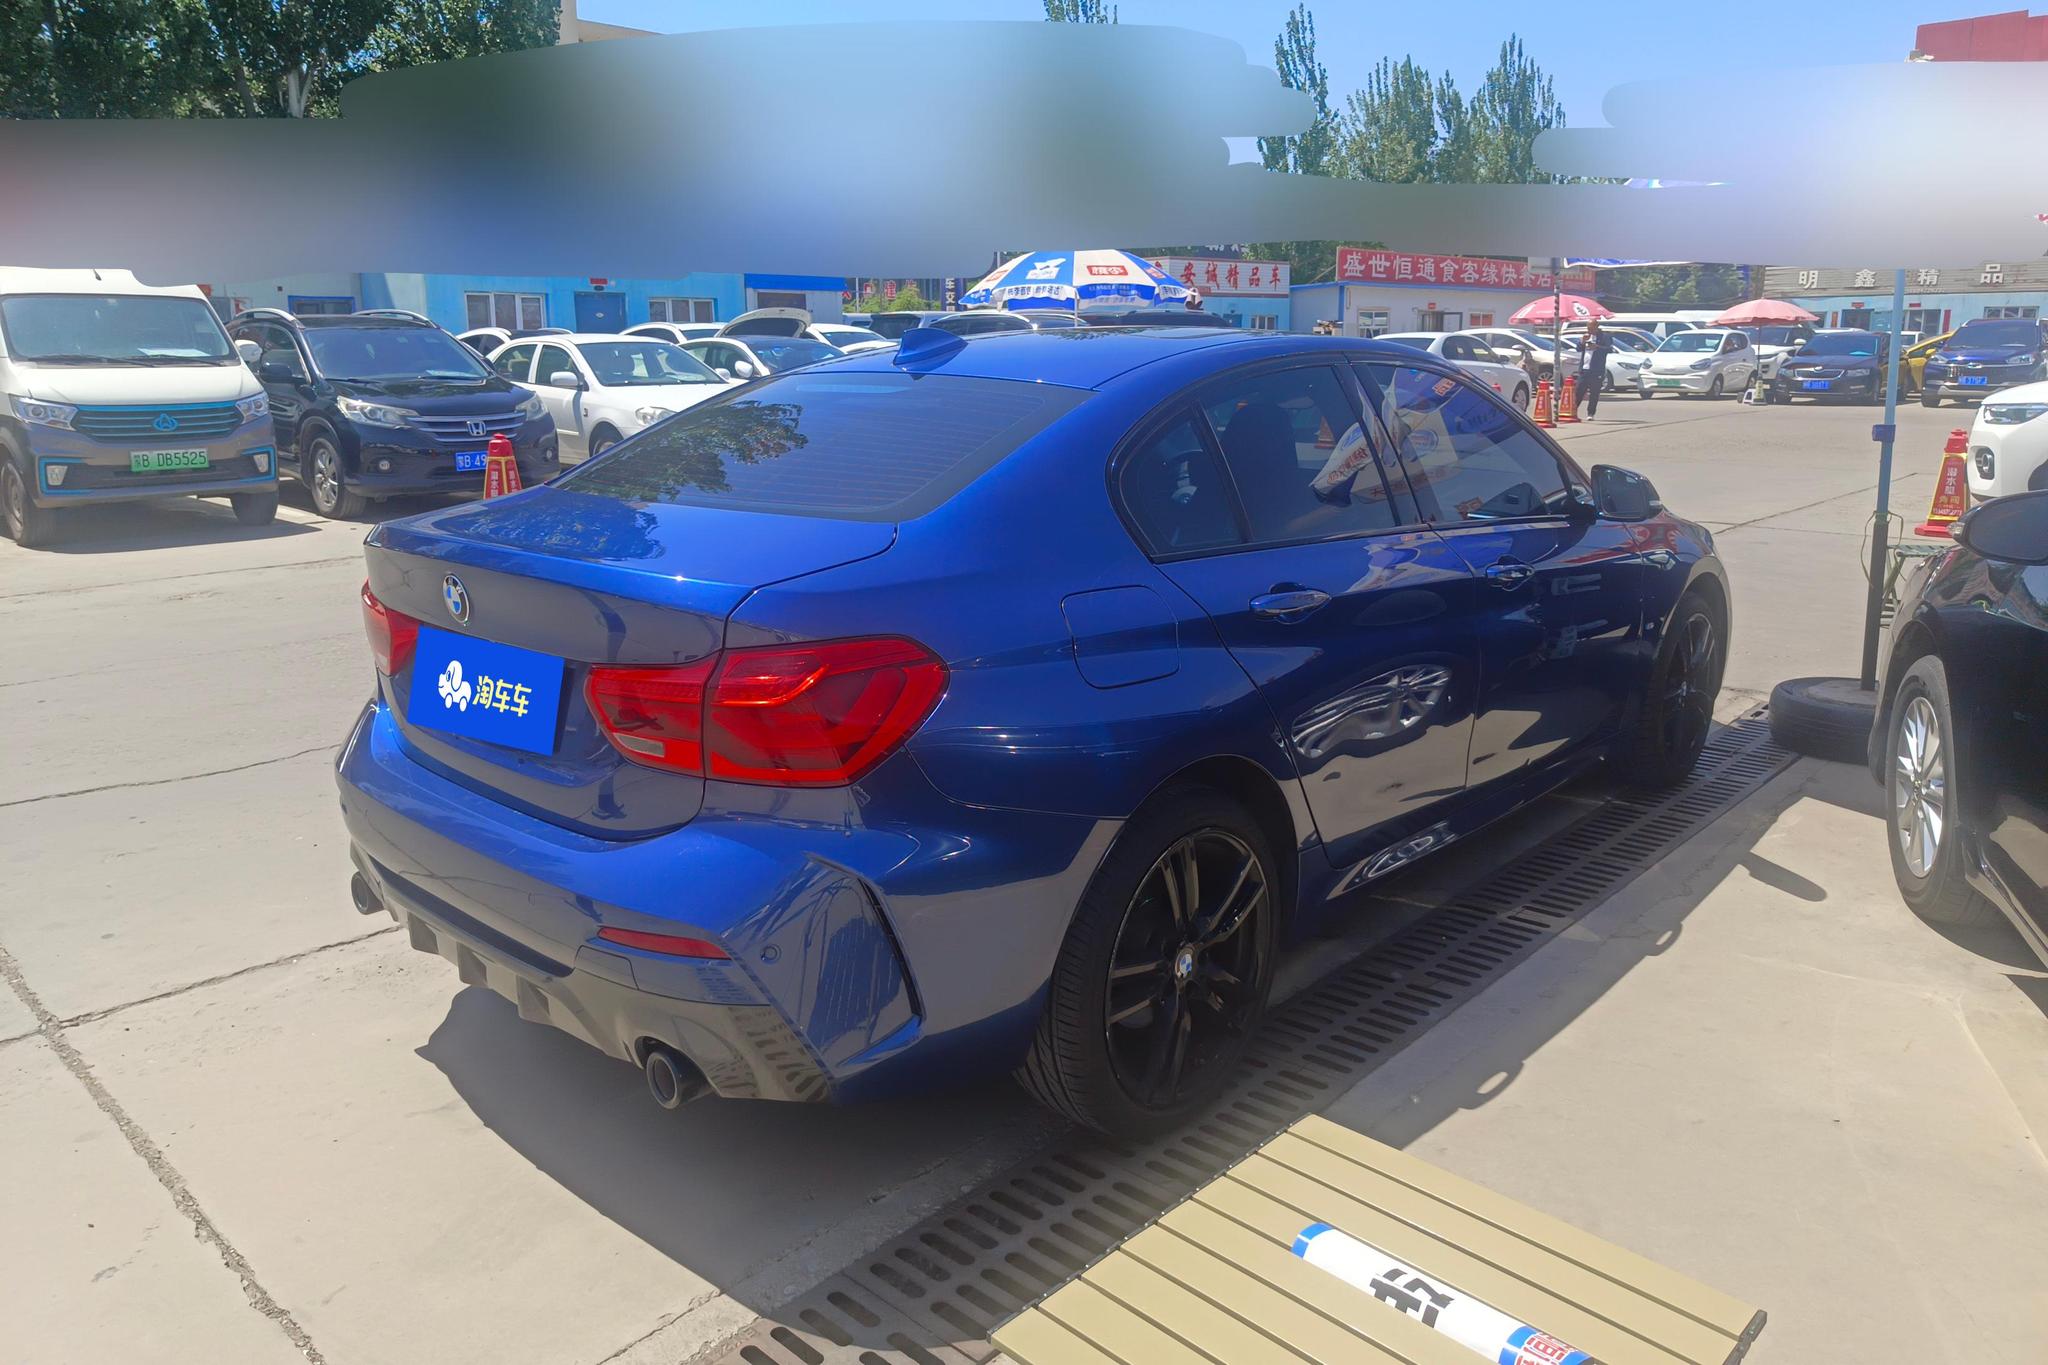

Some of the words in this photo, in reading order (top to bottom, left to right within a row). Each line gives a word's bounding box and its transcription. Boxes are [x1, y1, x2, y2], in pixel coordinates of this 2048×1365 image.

[1798, 263, 2005, 290] 明鑫精品
[156, 450, 207, 467] DB5525
